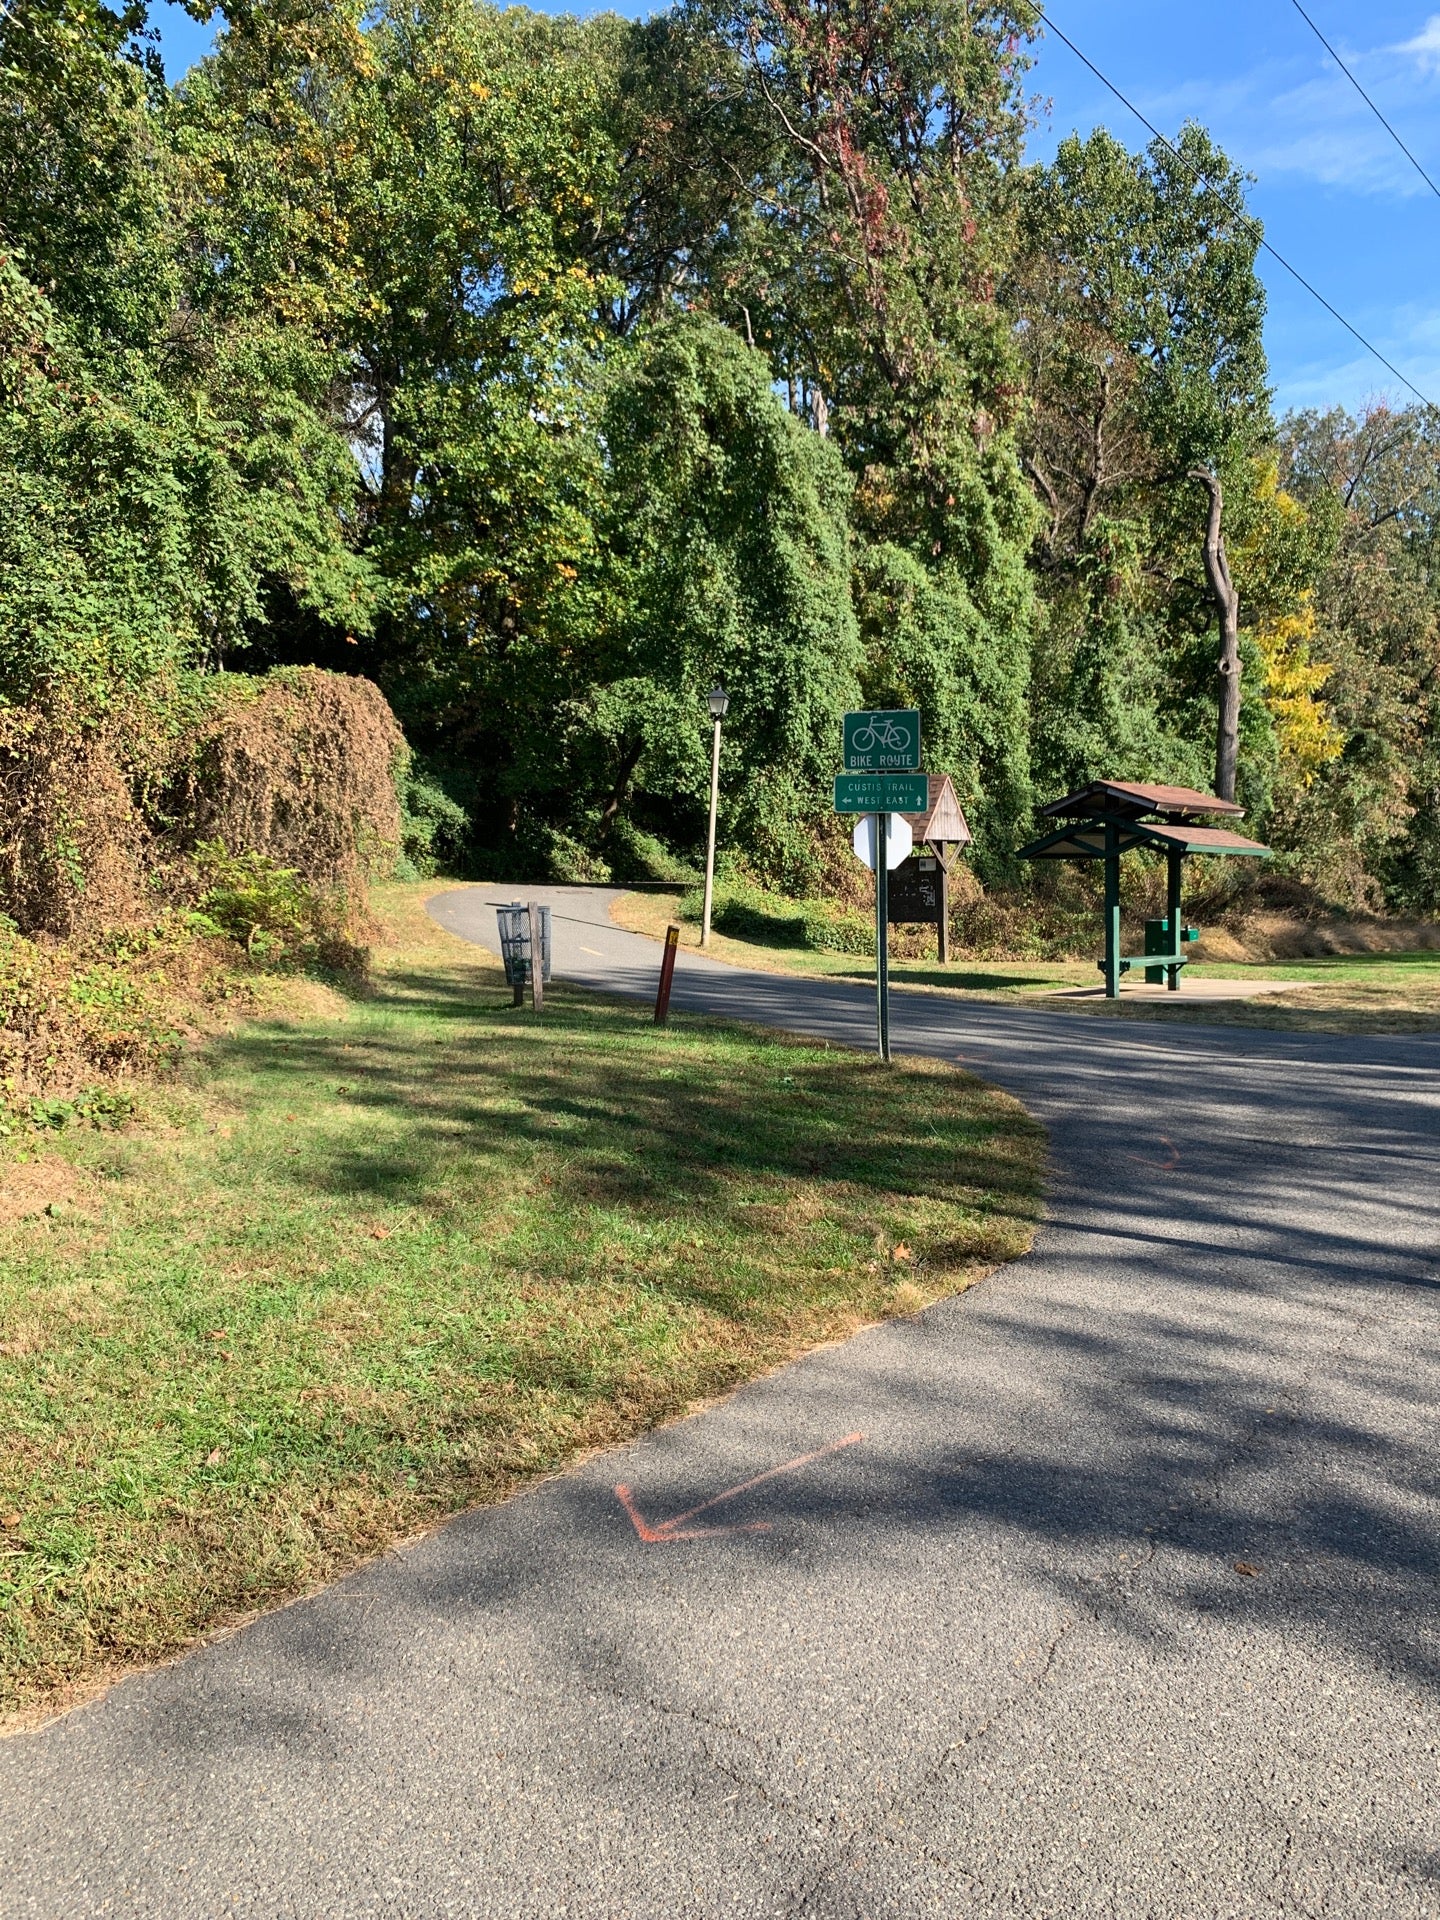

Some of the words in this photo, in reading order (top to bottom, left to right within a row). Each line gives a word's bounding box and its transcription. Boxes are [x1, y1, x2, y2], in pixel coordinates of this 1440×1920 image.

[850, 755, 872, 767] BIKE
[880, 754, 912, 766] ROUTE
[848, 783, 882, 791] CUSTIS
[888, 783, 914, 791] TRAIL
[857, 797, 880, 805] WEST
[886, 796, 908, 805] EAST
